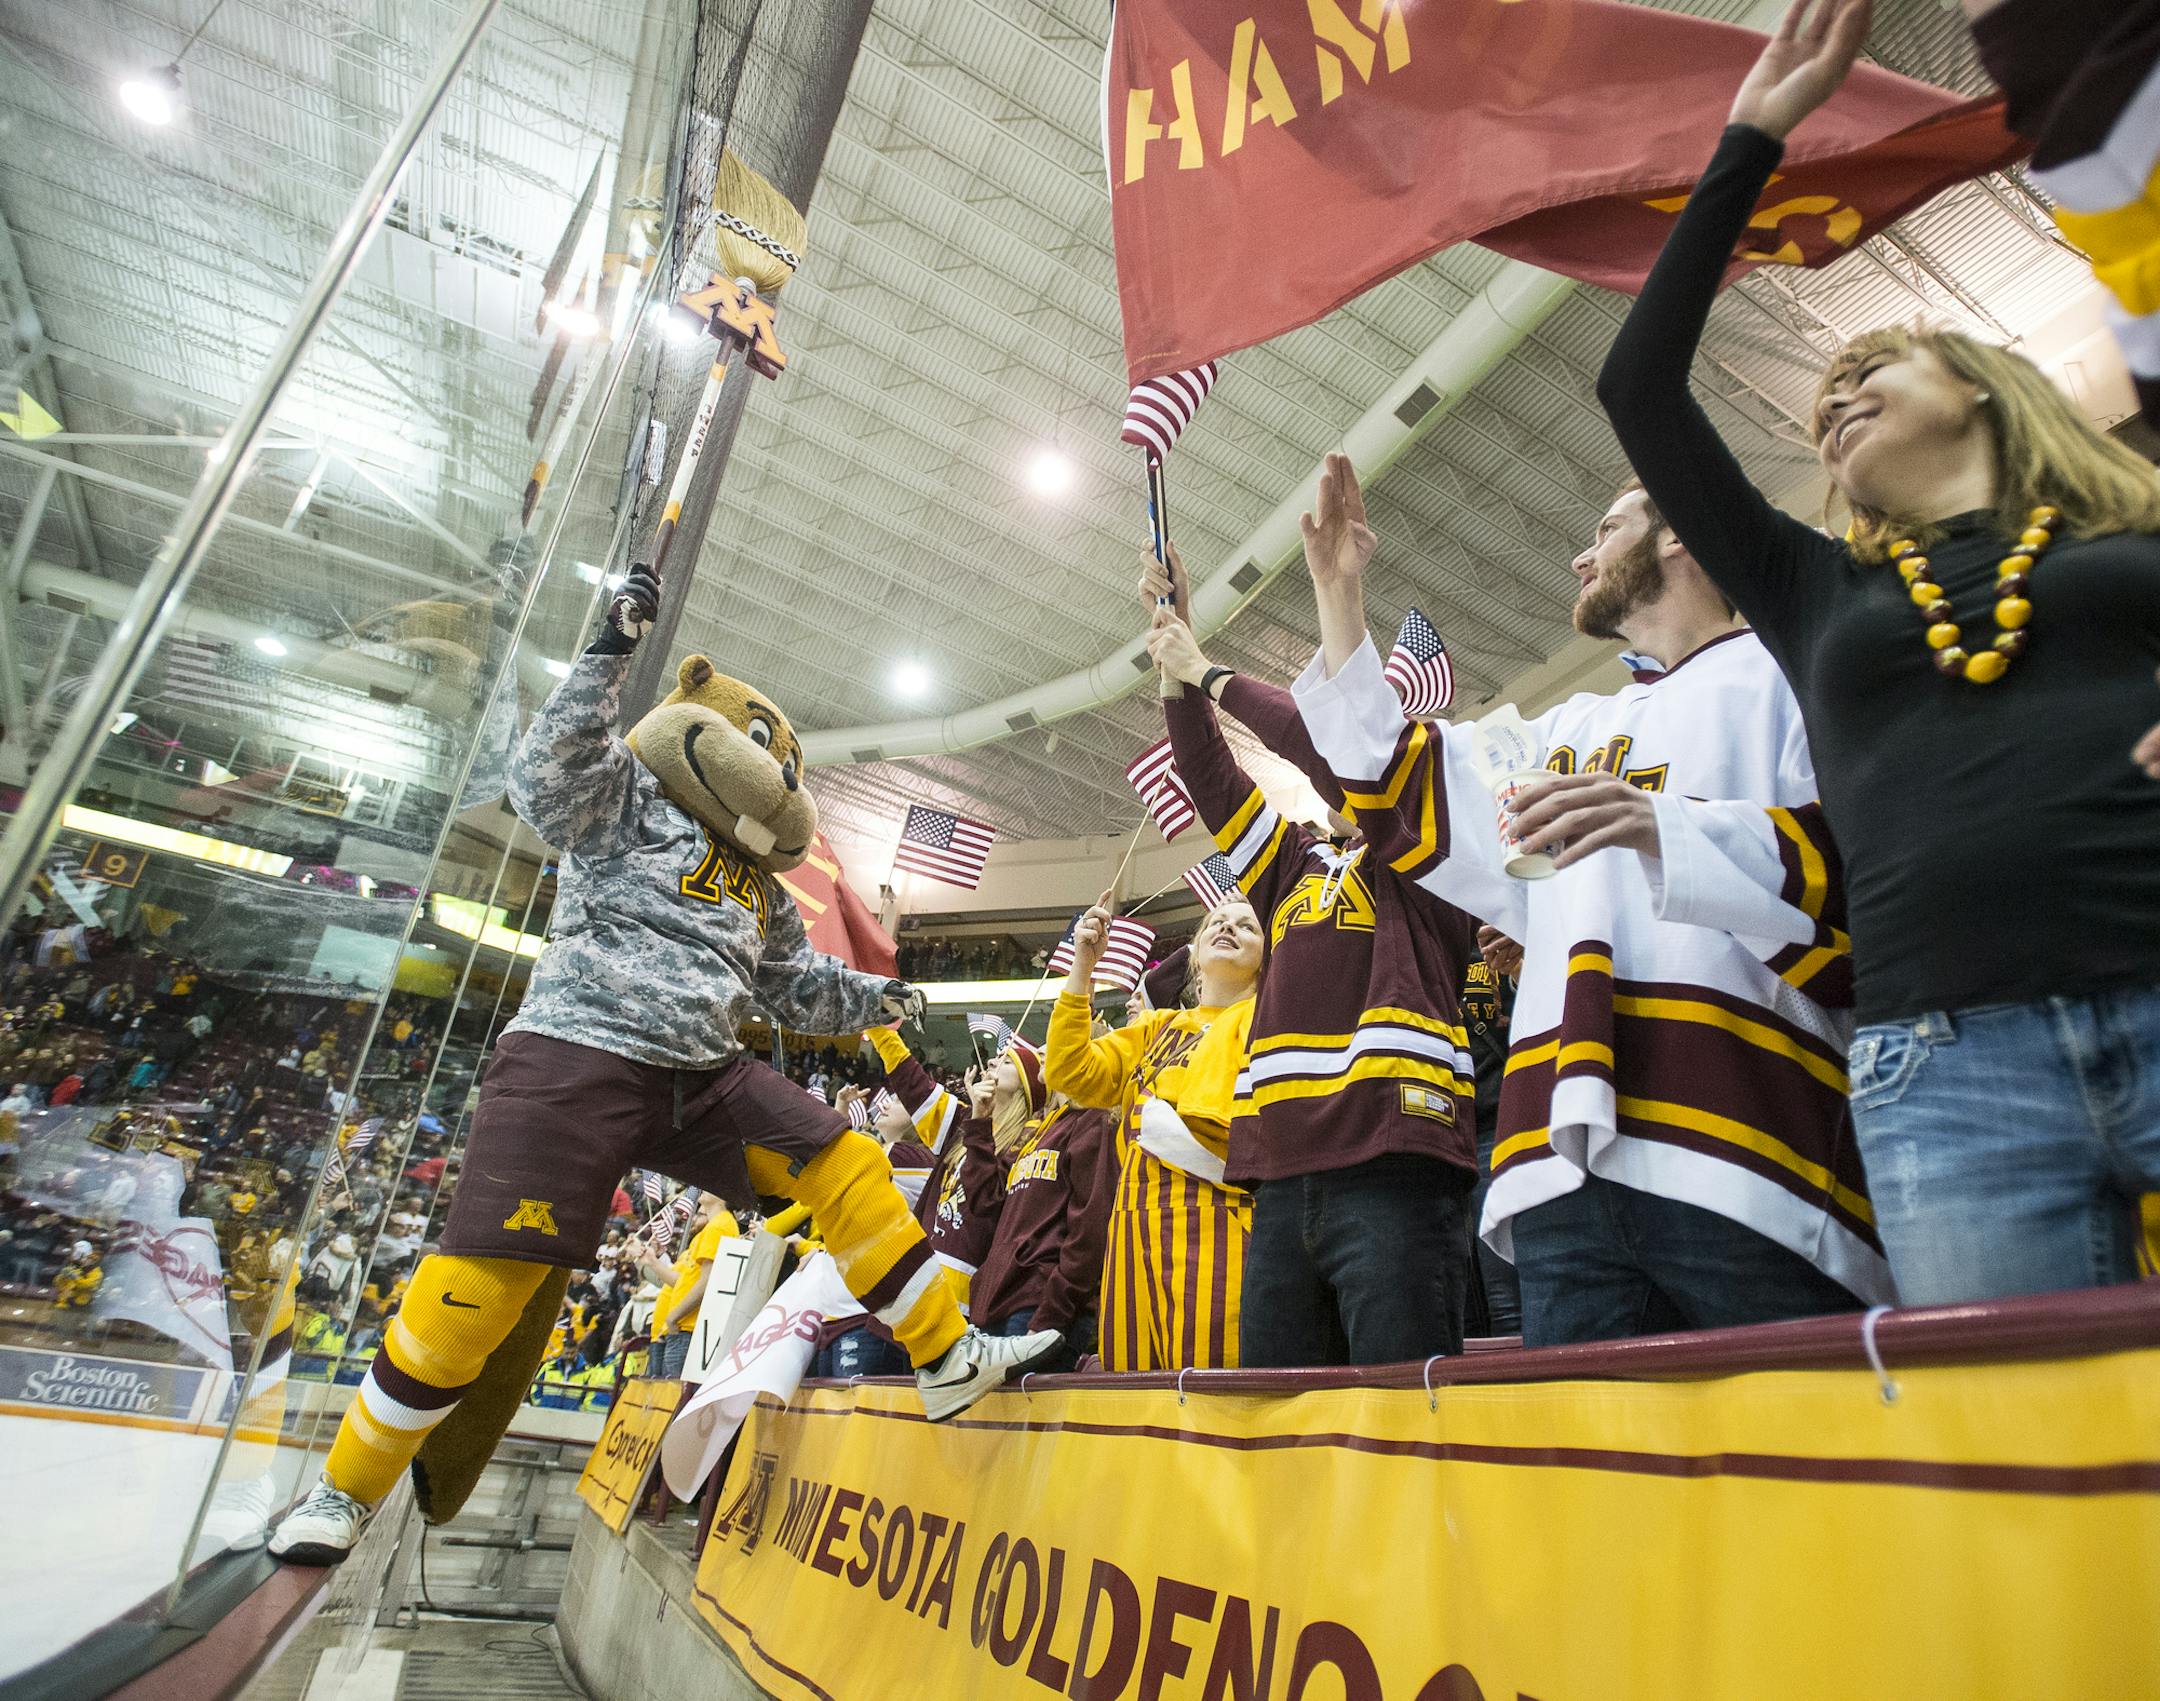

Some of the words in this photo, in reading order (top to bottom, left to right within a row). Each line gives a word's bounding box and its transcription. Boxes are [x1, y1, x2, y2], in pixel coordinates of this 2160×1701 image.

[1125, 0, 1412, 185] HAM
[104, 854, 127, 876] 9
[503, 1199, 559, 1236] M
[19, 1370, 160, 1412] Scientific
[49, 1357, 138, 1388] Boston
